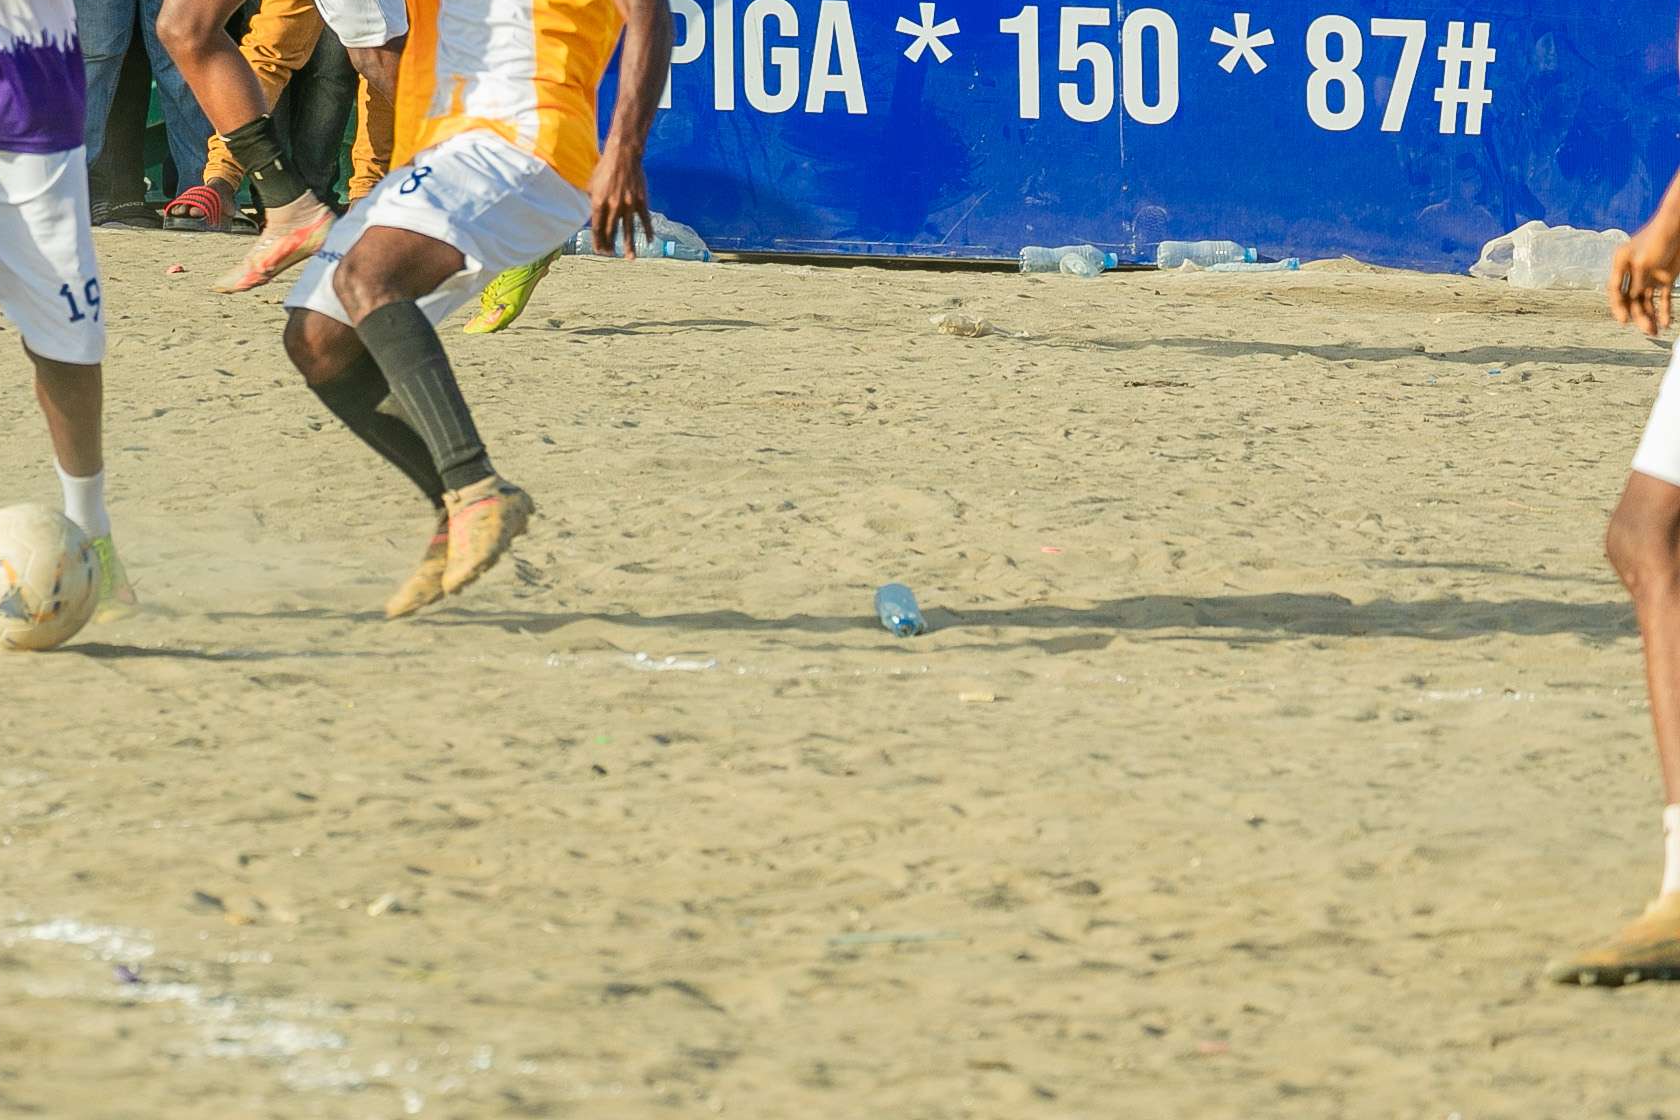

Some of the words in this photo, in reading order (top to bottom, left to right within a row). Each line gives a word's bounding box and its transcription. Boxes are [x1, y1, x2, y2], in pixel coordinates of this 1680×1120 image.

[999, 5, 1180, 125] 150
[1305, 14, 1498, 136] 87#
[400, 166, 432, 195] 8
[60, 277, 100, 323] 19
